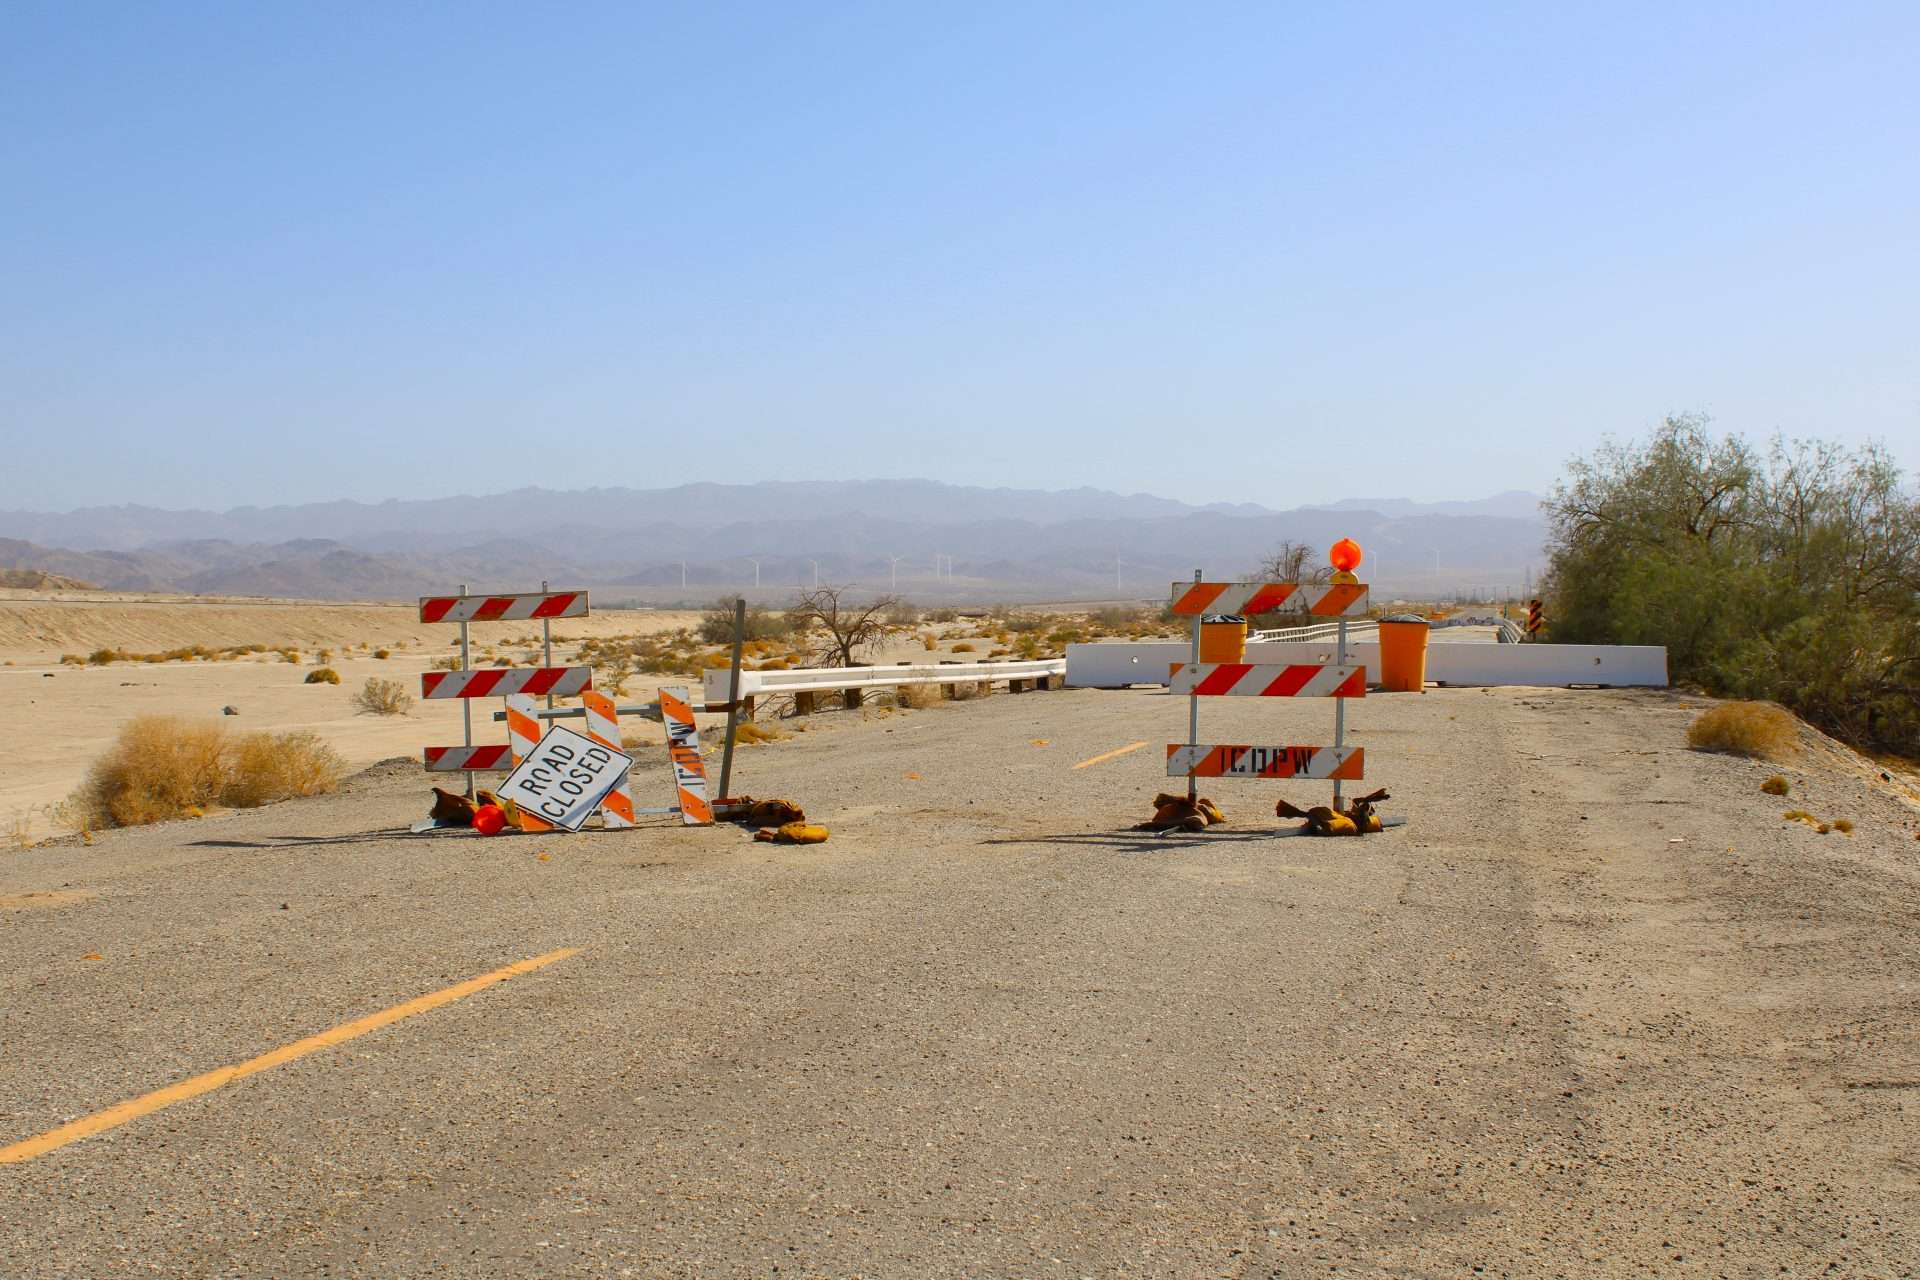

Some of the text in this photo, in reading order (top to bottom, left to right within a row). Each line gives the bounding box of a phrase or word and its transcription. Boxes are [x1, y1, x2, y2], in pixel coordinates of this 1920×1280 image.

[519, 744, 575, 796] ROAD
[540, 747, 611, 818] CLOSED
[1220, 746, 1313, 775] ICDPW
